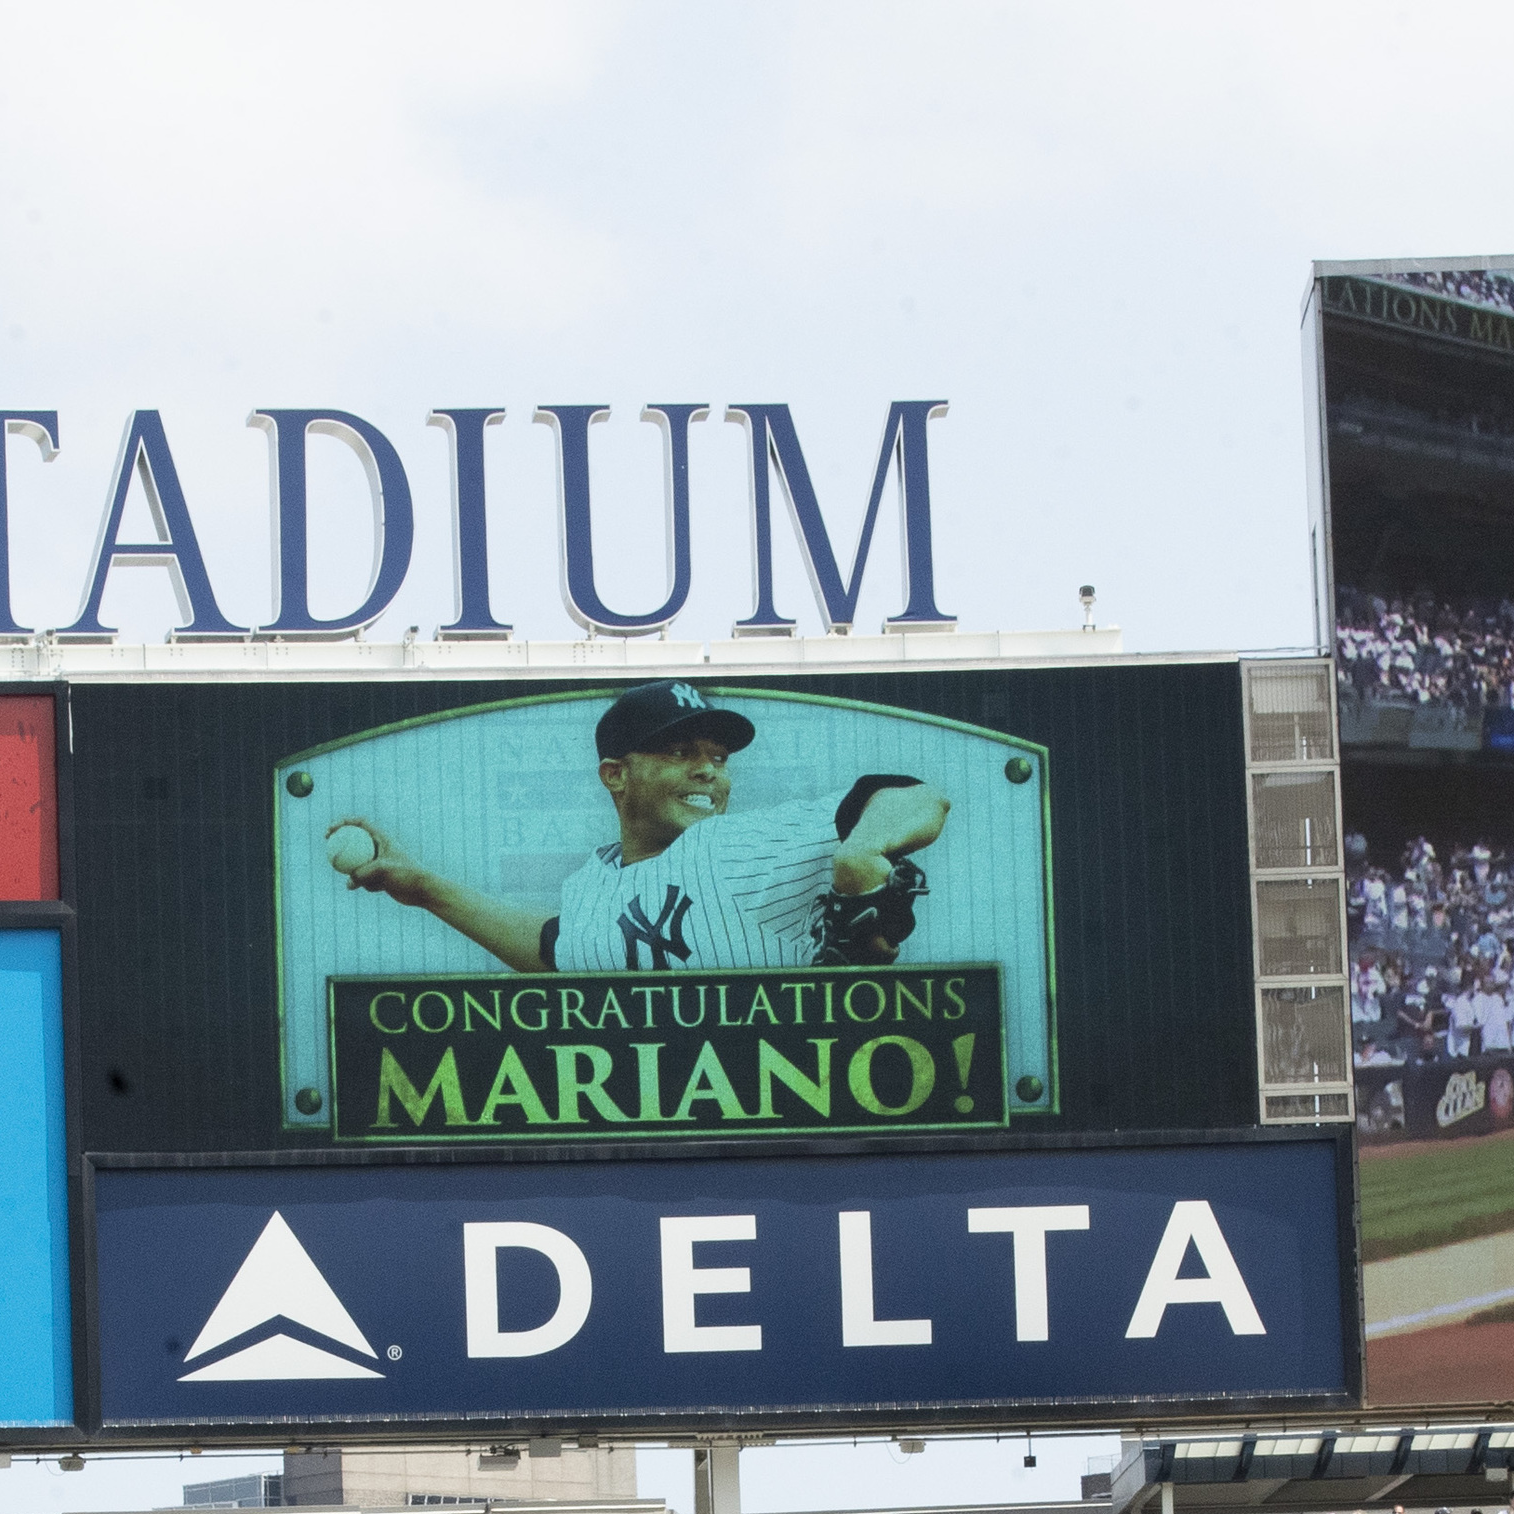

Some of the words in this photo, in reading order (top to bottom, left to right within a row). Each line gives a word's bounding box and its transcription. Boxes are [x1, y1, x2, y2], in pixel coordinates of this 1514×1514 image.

[368, 977, 967, 1036] CONGRATULATIONS
[369, 1030, 978, 1130] MARIANO!
[462, 1199, 1268, 1359] DELTA
